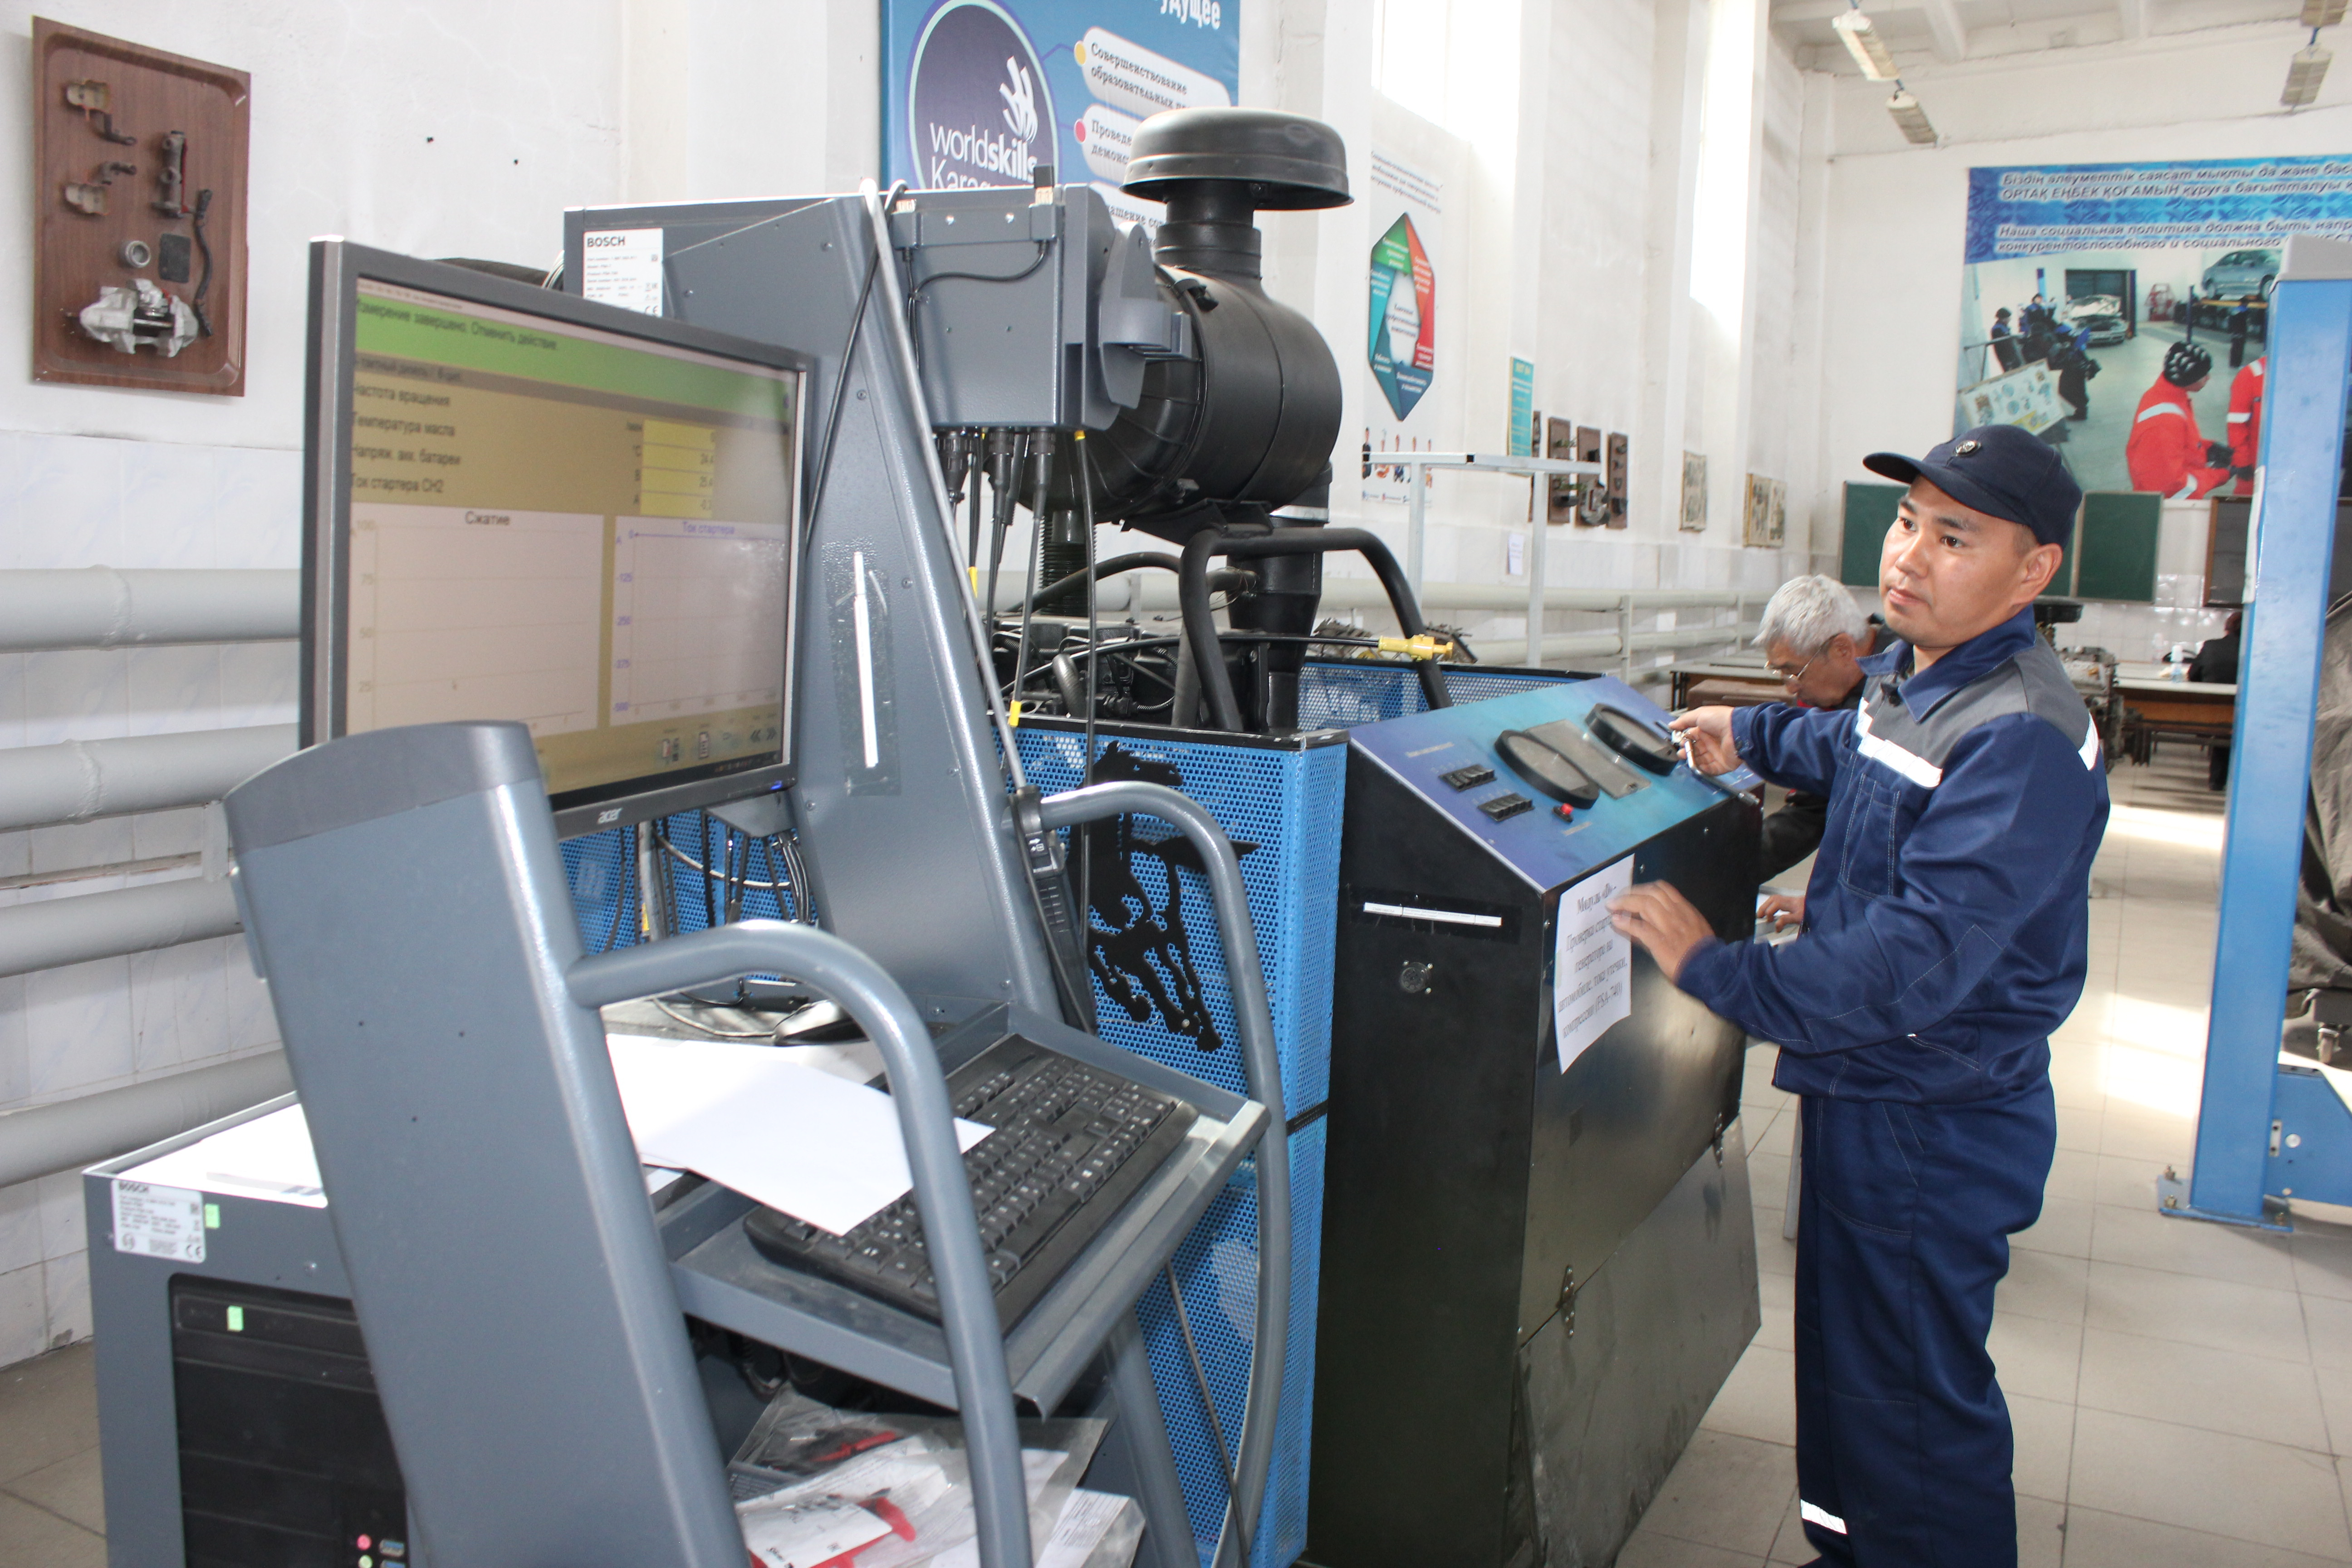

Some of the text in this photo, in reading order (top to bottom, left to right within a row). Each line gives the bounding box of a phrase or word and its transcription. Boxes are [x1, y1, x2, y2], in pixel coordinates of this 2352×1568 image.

[1091, 42, 1187, 95] Совершенствование
[1091, 66, 1173, 109] образовательных
[1092, 119, 1133, 147] Проведе
[930, 122, 1038, 184] worldskills
[1091, 144, 1130, 165] демонс
[2138, 171, 2191, 181] саясат
[2196, 168, 2254, 180] мықты
[2259, 165, 2276, 177] да
[2323, 162, 2352, 175] бәс
[2002, 187, 2048, 201] ОРТАҚ
[2051, 186, 2100, 200] ЕҢБЕК
[1999, 219, 2352, 237] Наша социальная политика должна быть напр
[588, 236, 625, 247] BOSCH
[1998, 239, 2166, 254] конкурентоспособного
[2170, 240, 2178, 248] и
[2183, 237, 2280, 249] социального
[399, 390, 450, 407] вращения
[371, 477, 419, 492] стартера
[465, 510, 510, 525] Сжатие
[598, 808, 623, 824] acer
[1578, 892, 1600, 914] Модуль
[1567, 925, 1594, 953] Проверка
